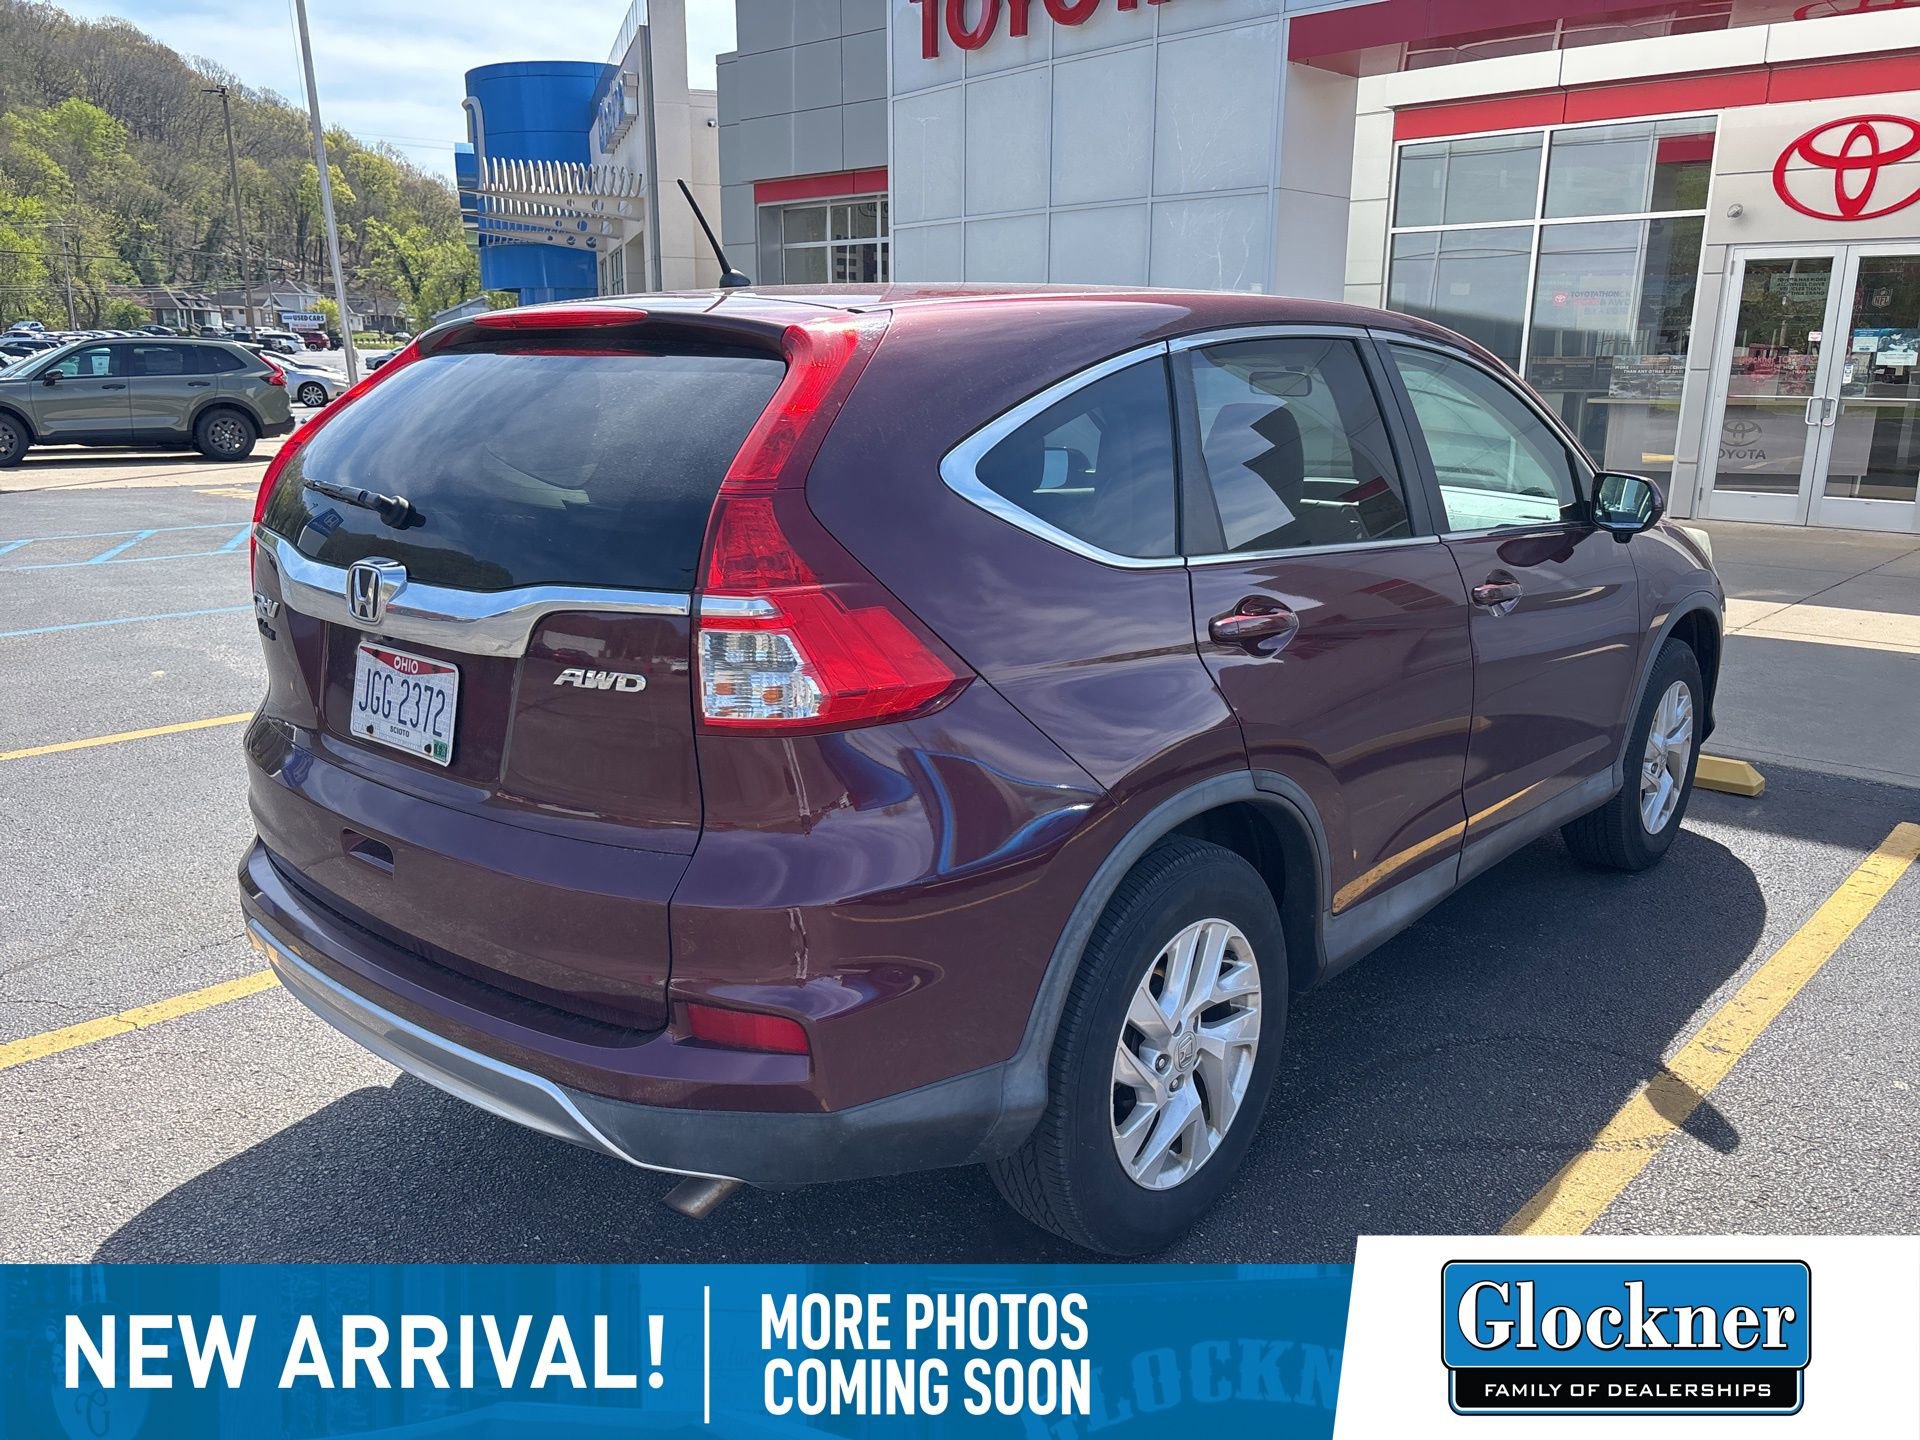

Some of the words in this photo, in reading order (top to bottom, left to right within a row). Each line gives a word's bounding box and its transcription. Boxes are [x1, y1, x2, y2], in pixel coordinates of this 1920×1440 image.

[910, 0, 1171, 59] TOY
[1719, 449, 1766, 459] OYOTA
[254, 591, 280, 618] R-V
[393, 656, 419, 674] OHIO
[553, 668, 647, 692] AWD
[359, 668, 394, 719] JGG
[398, 679, 446, 738] 2372
[390, 725, 410, 737] SCIOTO
